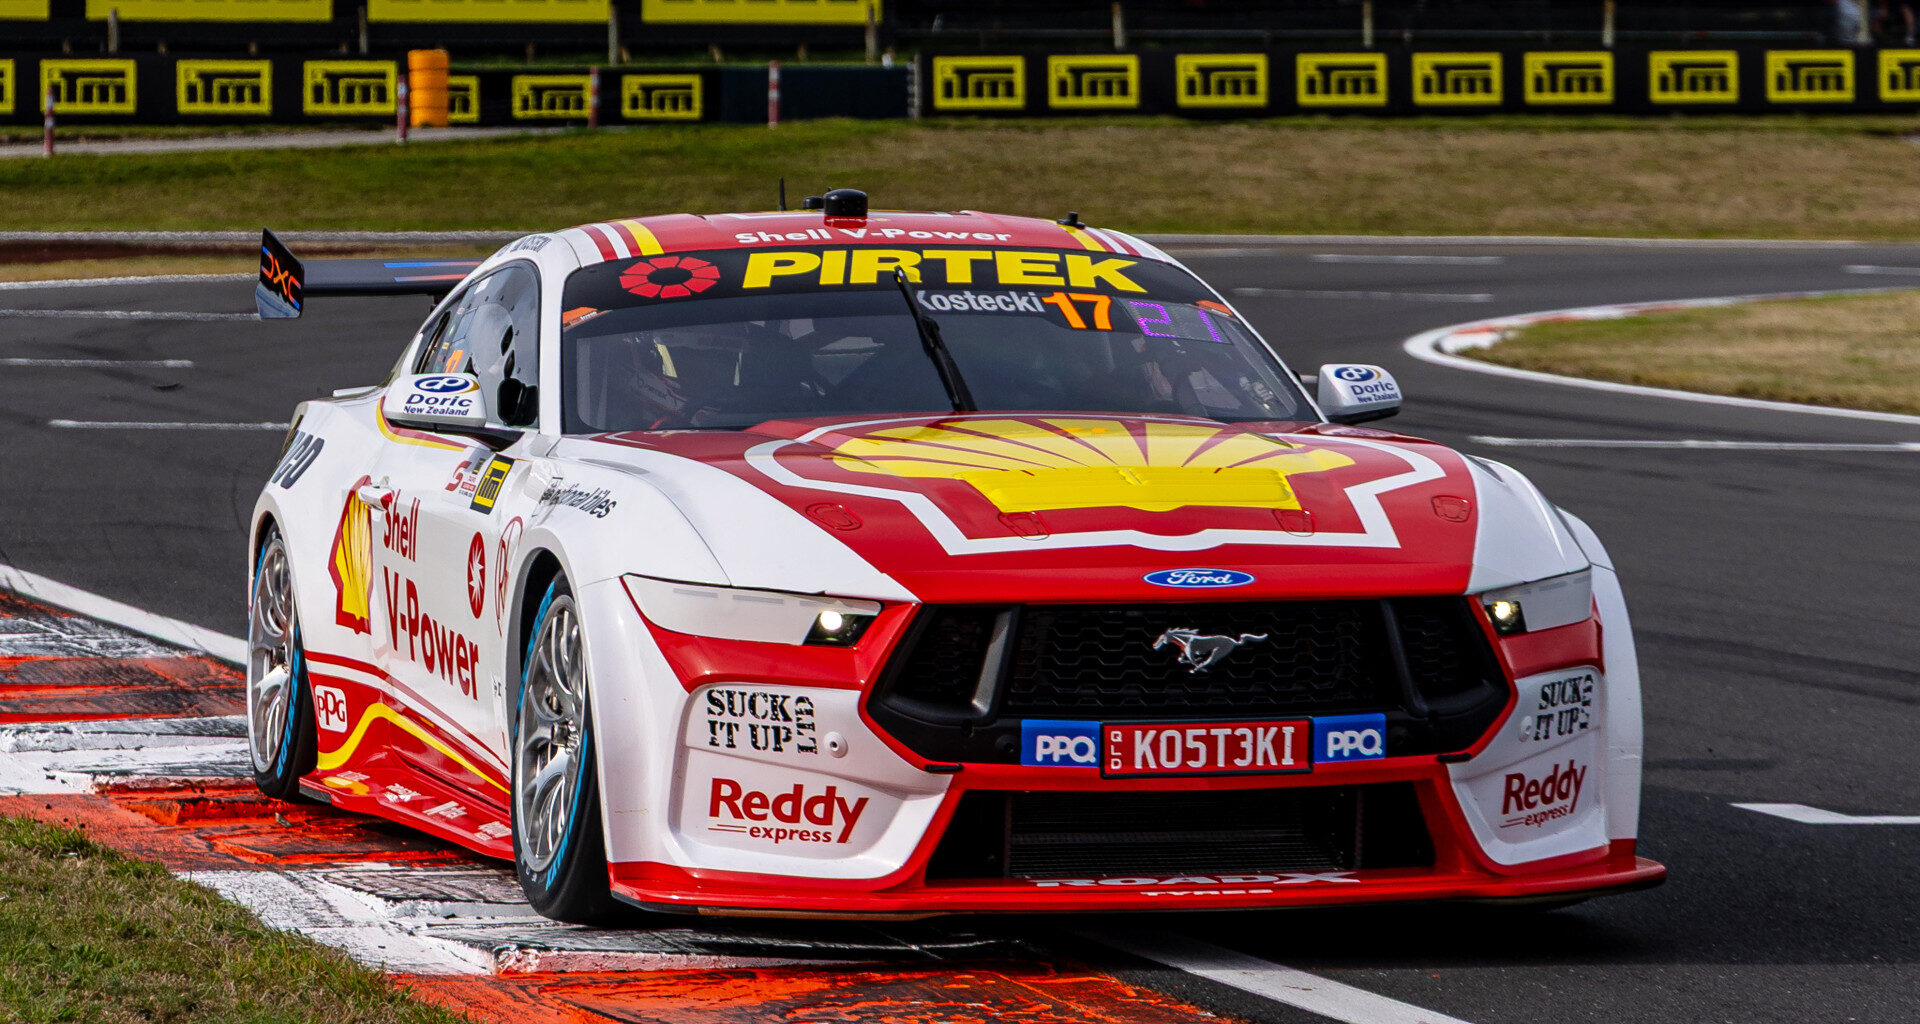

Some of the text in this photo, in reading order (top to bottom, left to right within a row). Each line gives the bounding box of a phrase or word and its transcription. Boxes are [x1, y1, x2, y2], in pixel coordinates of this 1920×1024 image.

[735, 228, 1011, 243] Shell V-Power
[742, 249, 1147, 293] PIRTEK
[1041, 291, 1112, 330] 17
[1129, 300, 1222, 343] 21
[405, 393, 473, 407] Doric
[1350, 381, 1395, 395] Doric
[403, 405, 470, 416] New Zealand
[384, 488, 421, 562] Shell
[1163, 570, 1237, 585] Ford
[383, 564, 479, 701] V-Power
[317, 690, 346, 726] PPG
[706, 689, 792, 722] SUCK
[1539, 677, 1583, 710] SUCK
[708, 720, 792, 752] IT UP
[1533, 707, 1580, 741] IT UP
[1036, 735, 1096, 763] PPQ
[1110, 731, 1122, 770] QLD
[1326, 729, 1383, 757] PPQ
[1502, 759, 1587, 815] Reddy
[709, 777, 870, 843] Reddy
[1524, 805, 1569, 828] express
[749, 825, 832, 843] express
[1033, 872, 1361, 887] ROADX
